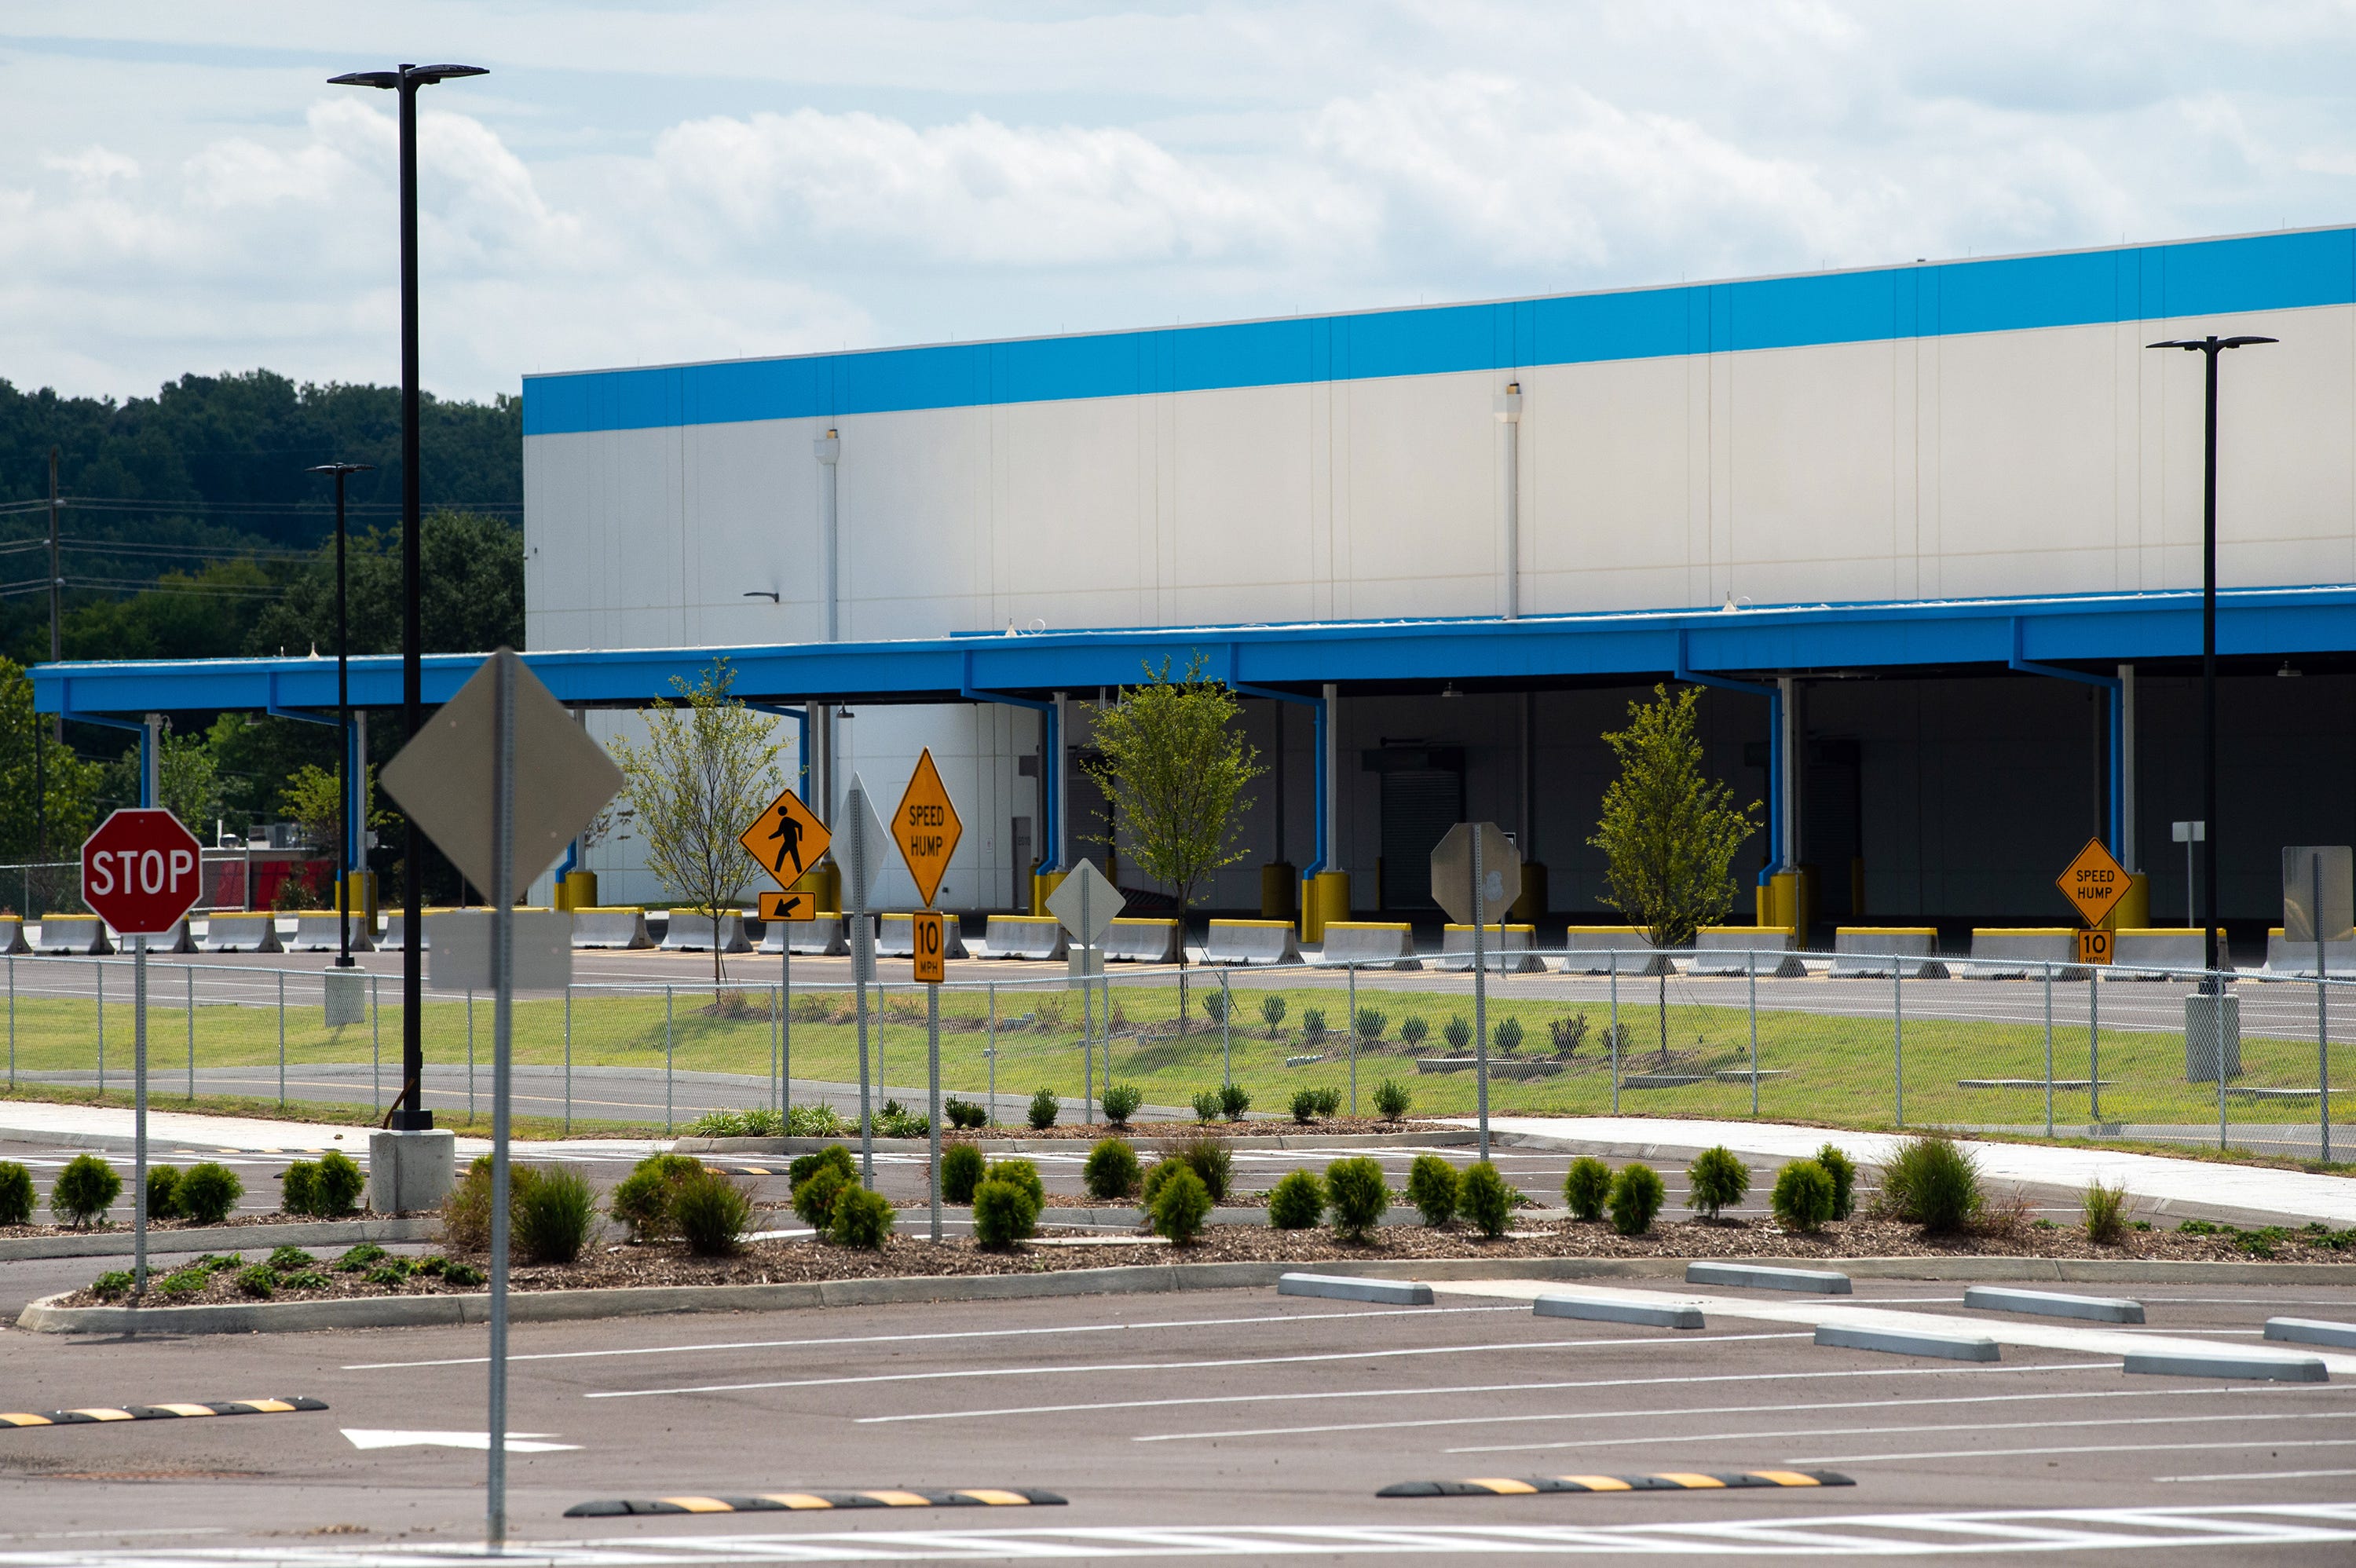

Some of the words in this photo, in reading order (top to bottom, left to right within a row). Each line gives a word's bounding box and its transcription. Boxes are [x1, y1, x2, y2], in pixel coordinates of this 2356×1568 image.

[909, 805, 944, 826] SPEED
[911, 835, 943, 857] HUMP
[90, 849, 193, 896] STOP
[2076, 870, 2115, 883] SPEED
[2078, 887, 2113, 899] HUMP
[920, 921, 938, 955] 10
[2084, 934, 2106, 954] 10
[920, 961, 938, 974] MPH
